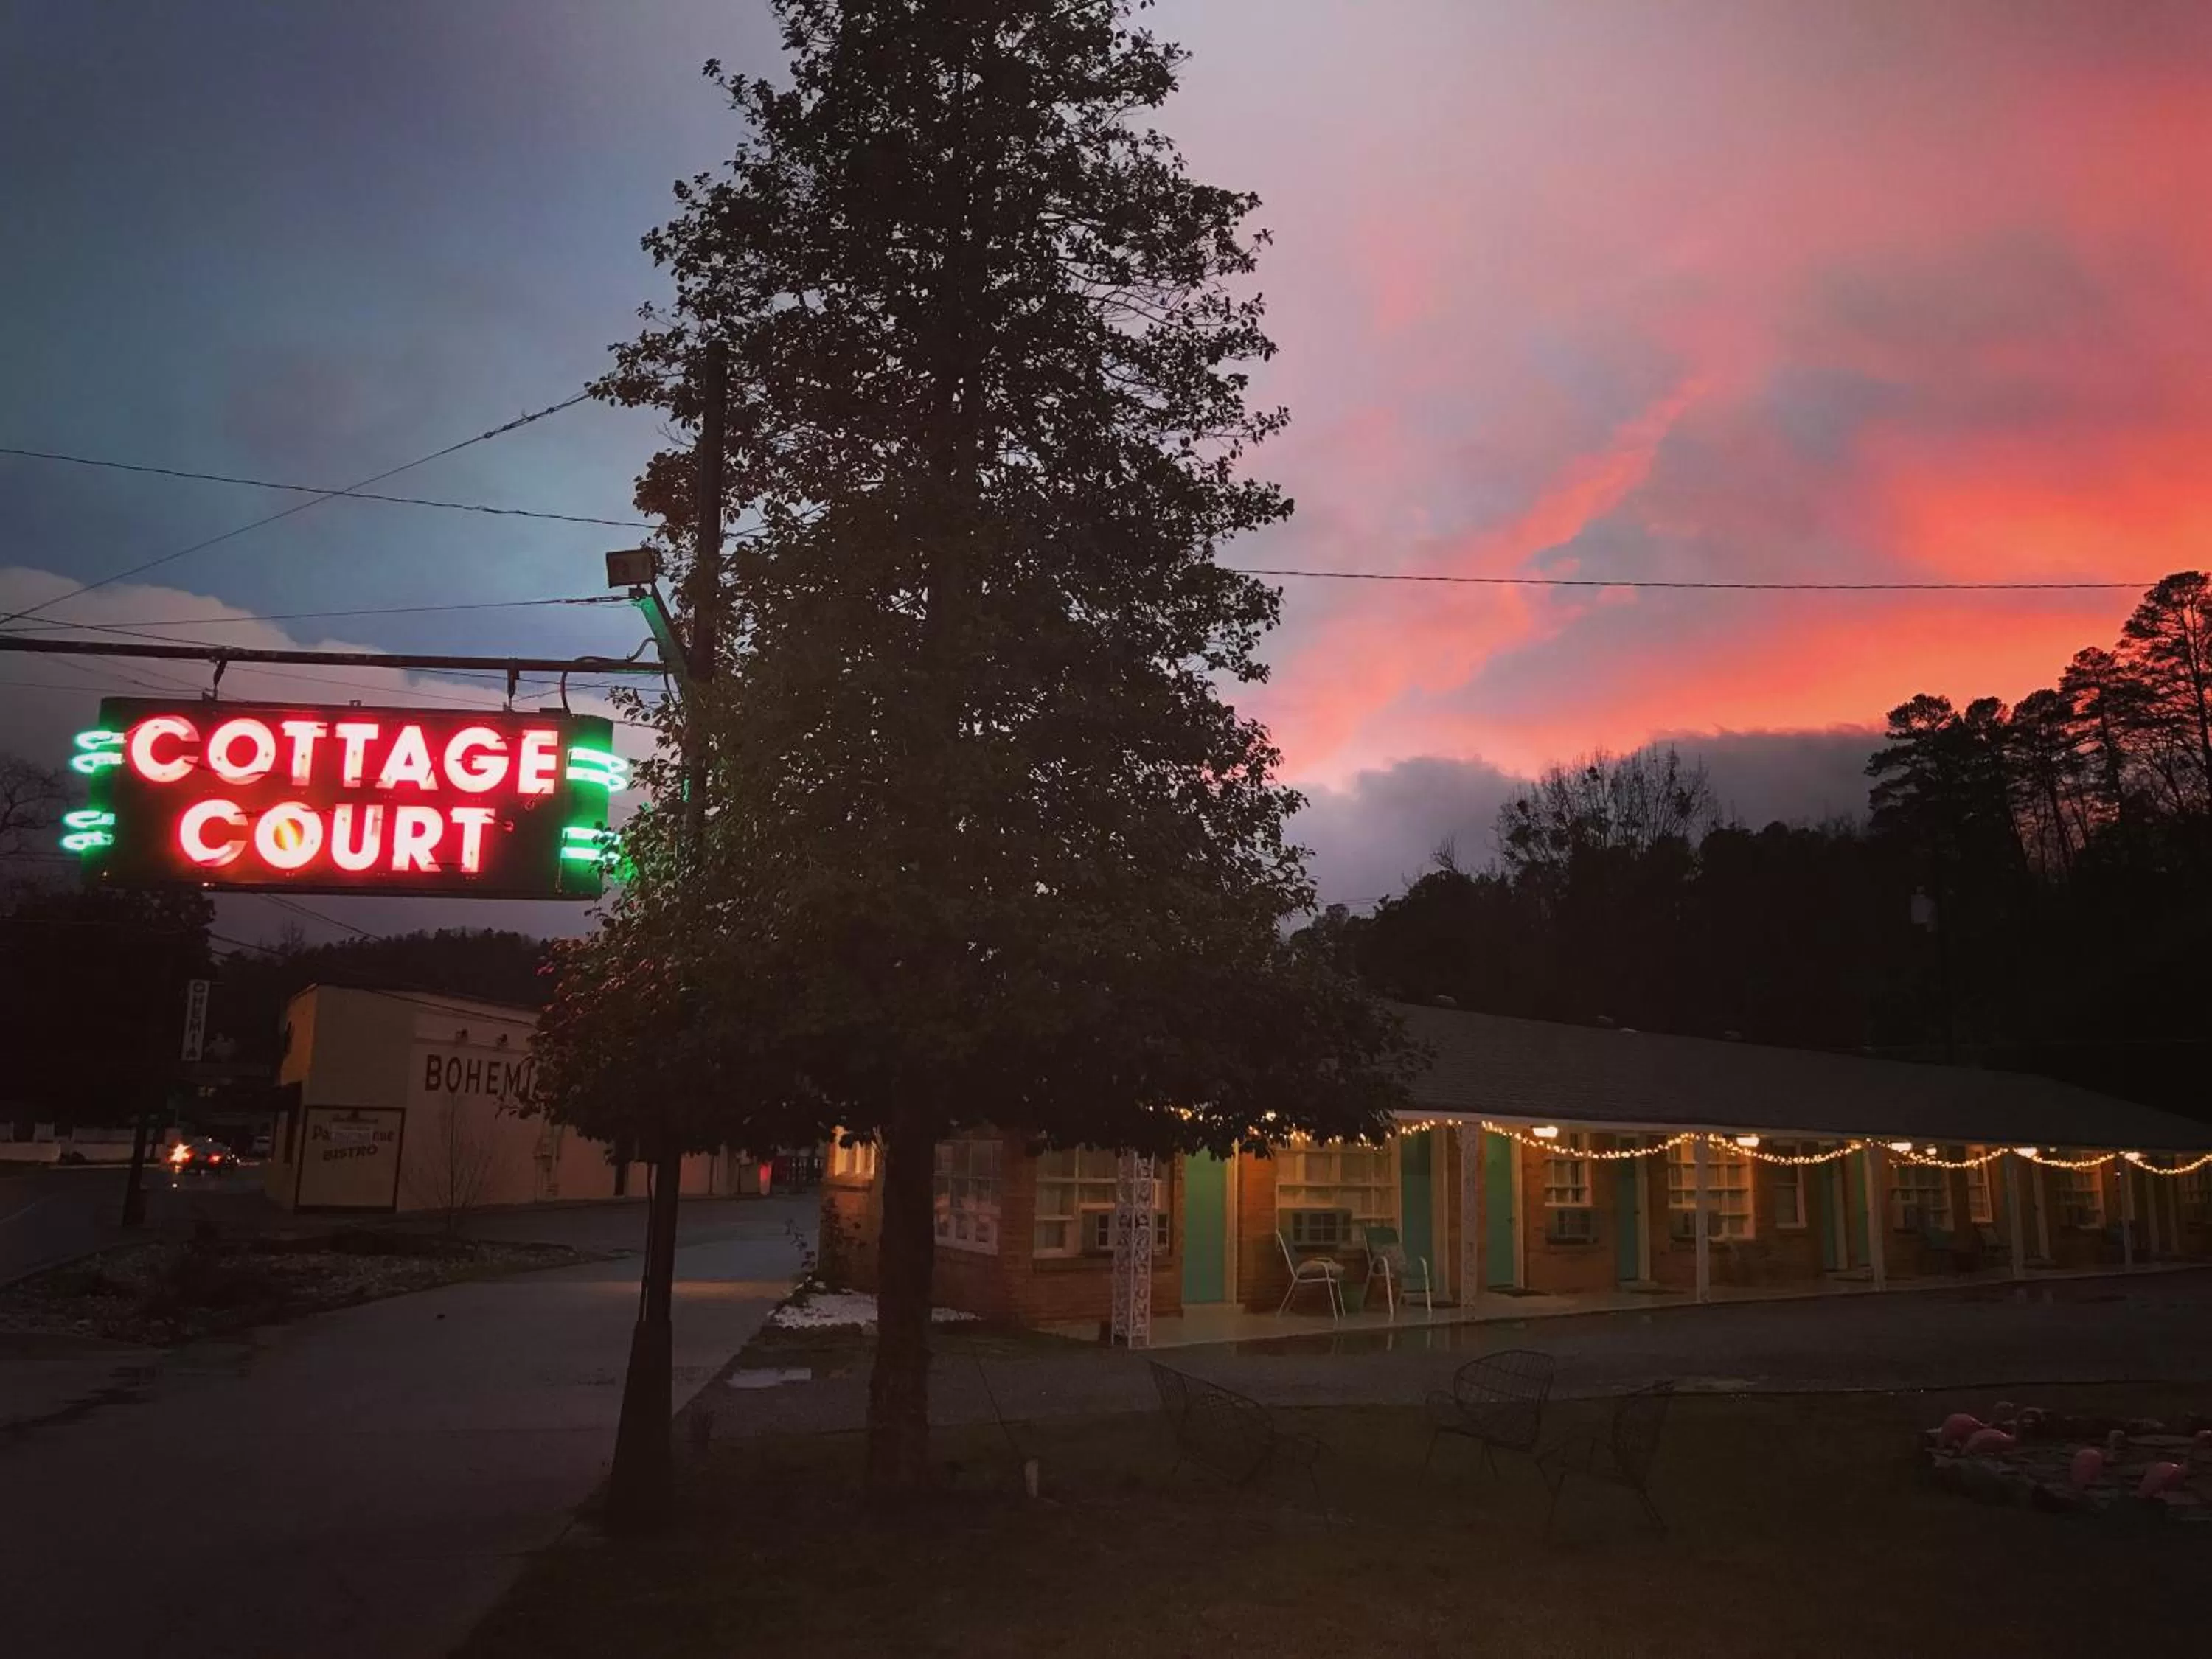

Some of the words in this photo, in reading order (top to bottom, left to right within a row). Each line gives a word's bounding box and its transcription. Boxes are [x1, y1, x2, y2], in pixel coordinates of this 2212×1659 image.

[131, 714, 559, 794] COTTAGE
[179, 799, 496, 873] COURT
[424, 1054, 540, 1097] BOHEMI
